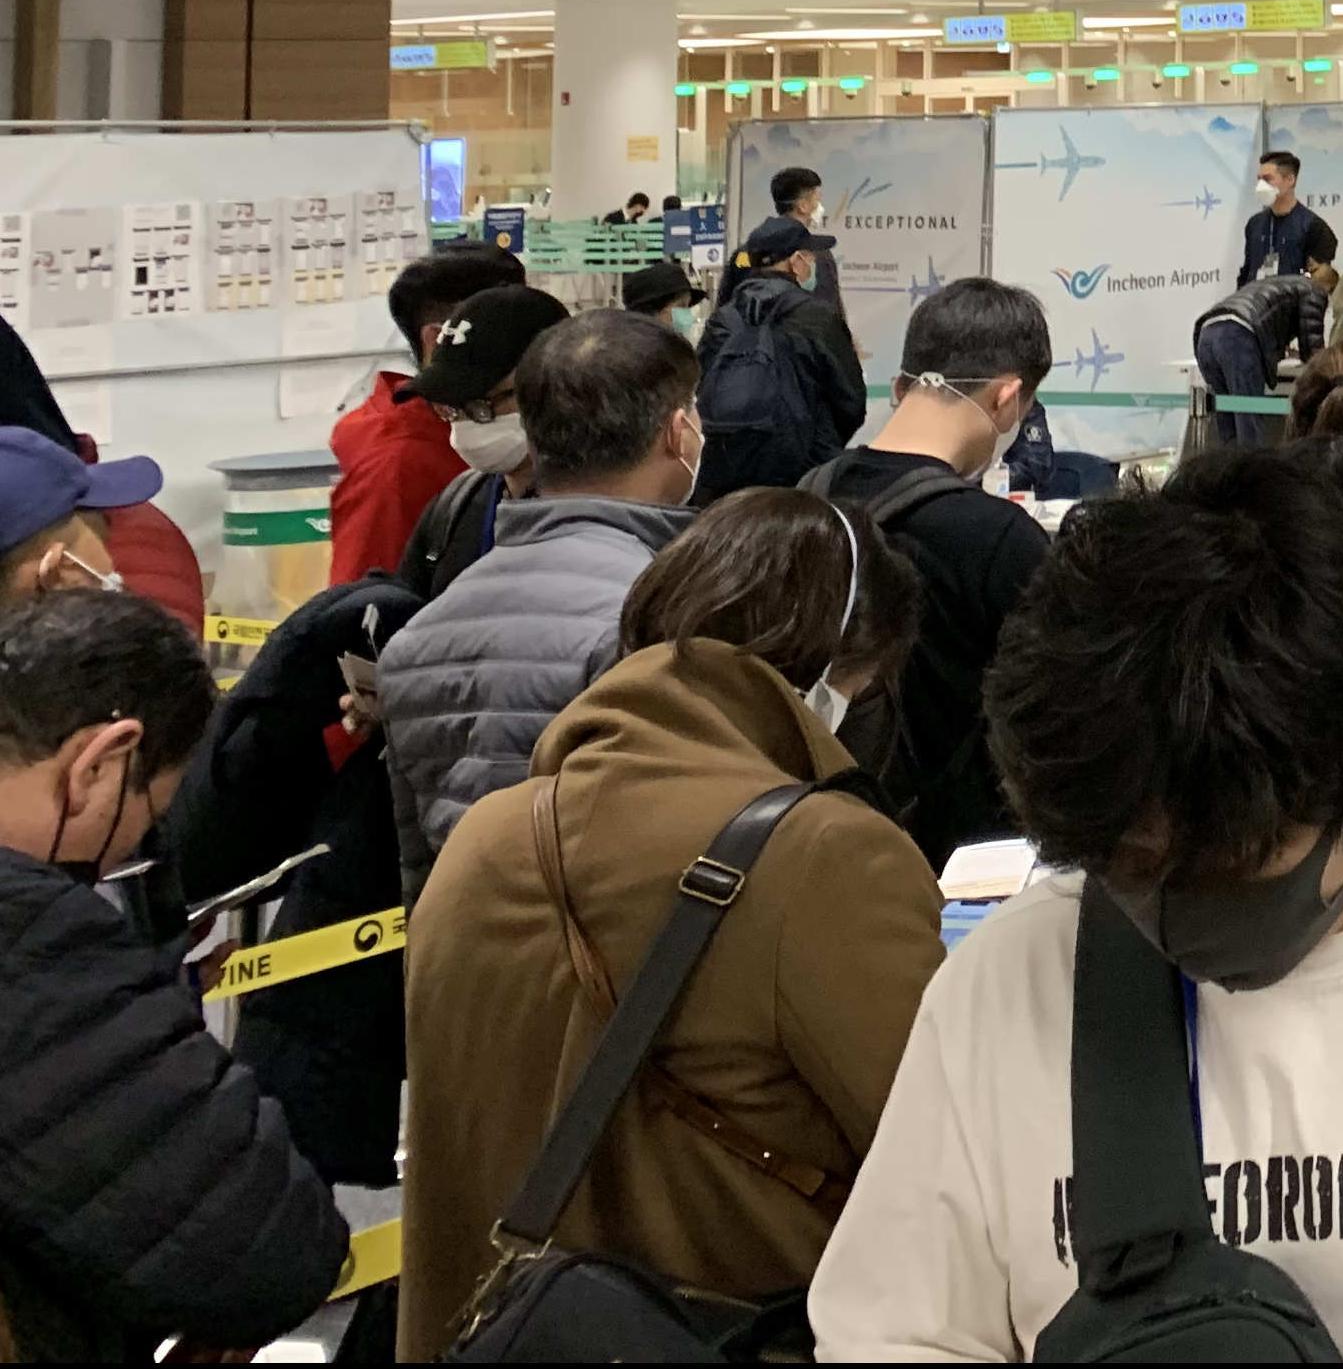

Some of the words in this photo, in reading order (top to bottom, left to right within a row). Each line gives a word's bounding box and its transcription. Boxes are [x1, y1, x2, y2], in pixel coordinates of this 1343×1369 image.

[844, 215, 958, 230] EXCEPTIONAL
[1107, 273, 1166, 293] Incheon
[1170, 268, 1221, 288] Airport
